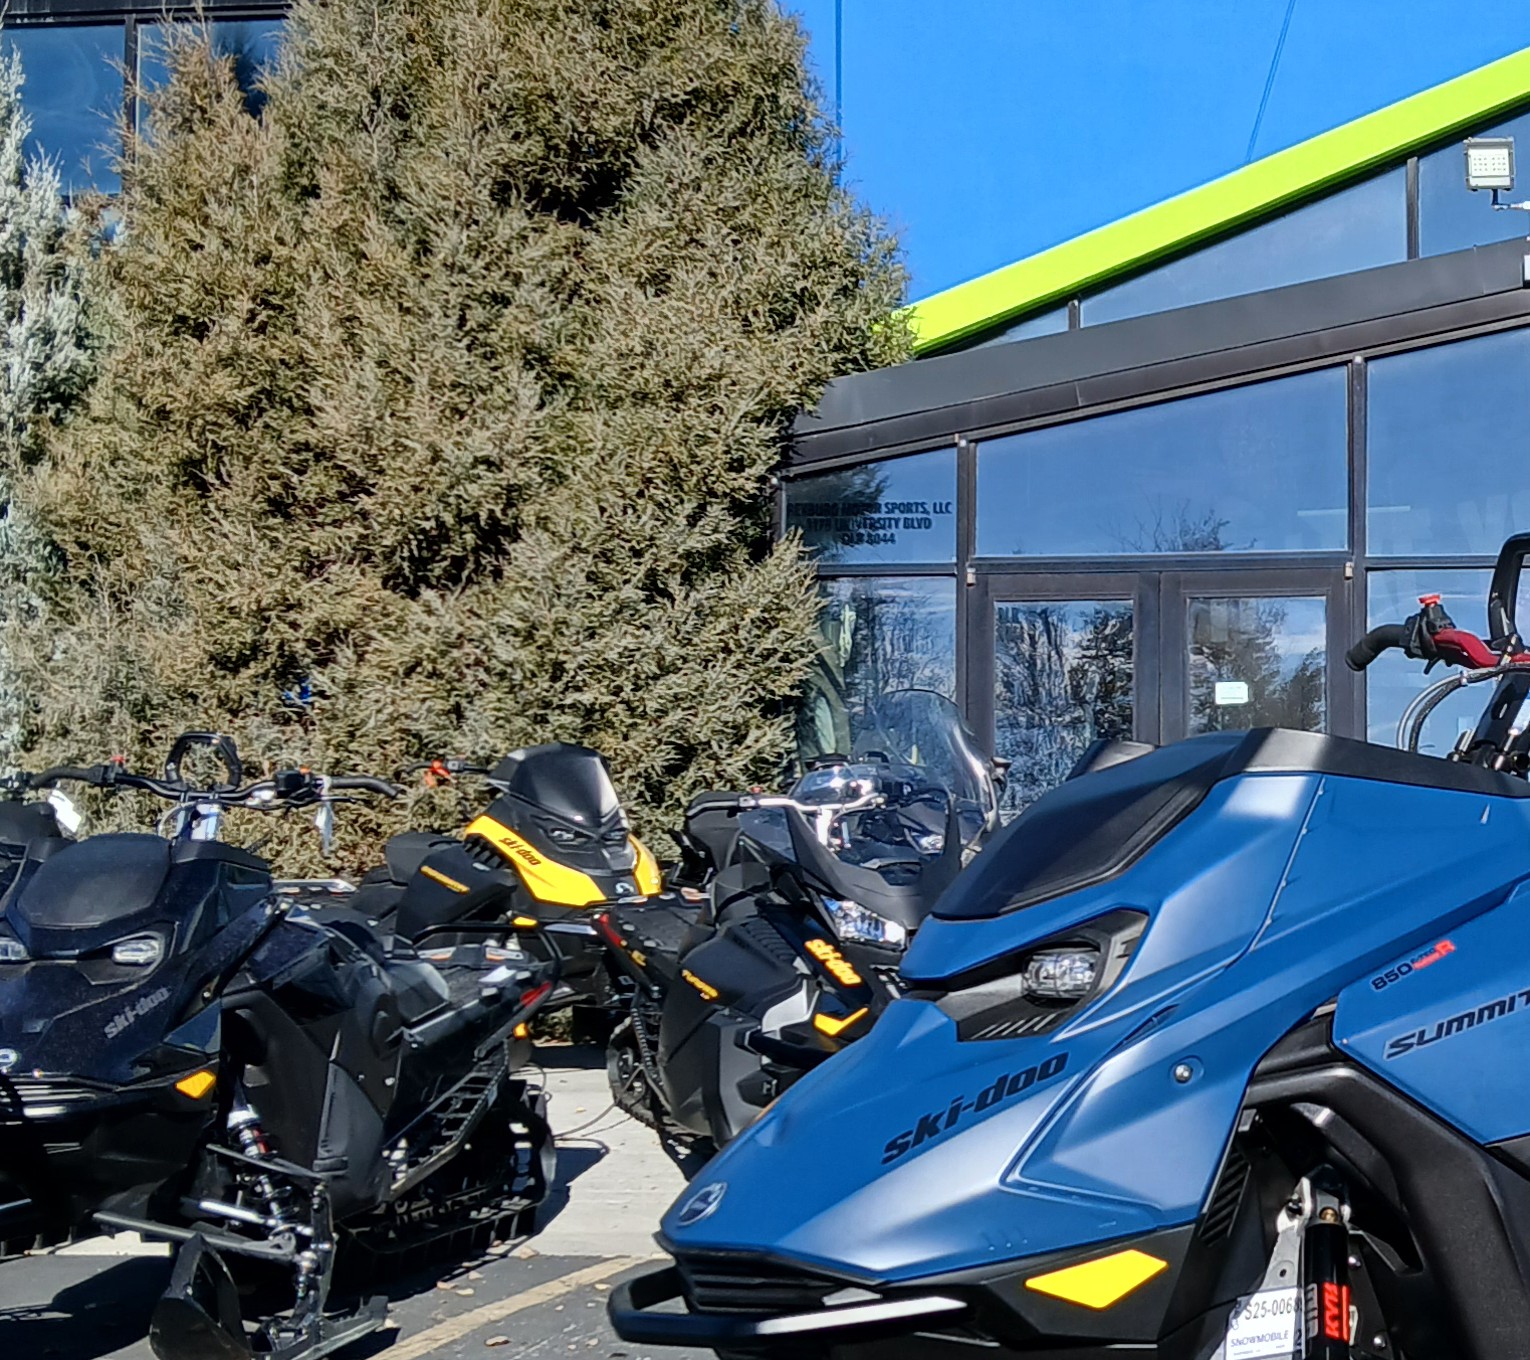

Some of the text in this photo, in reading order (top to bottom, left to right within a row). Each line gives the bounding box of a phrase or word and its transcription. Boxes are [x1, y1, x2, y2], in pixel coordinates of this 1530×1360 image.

[933, 501, 953, 515] LLC
[902, 517, 932, 530] BLVD
[1370, 961, 1413, 991] 850
[880, 1051, 1070, 1166] ski-doo
[1230, 1330, 1289, 1347] SNOWMOBILE
